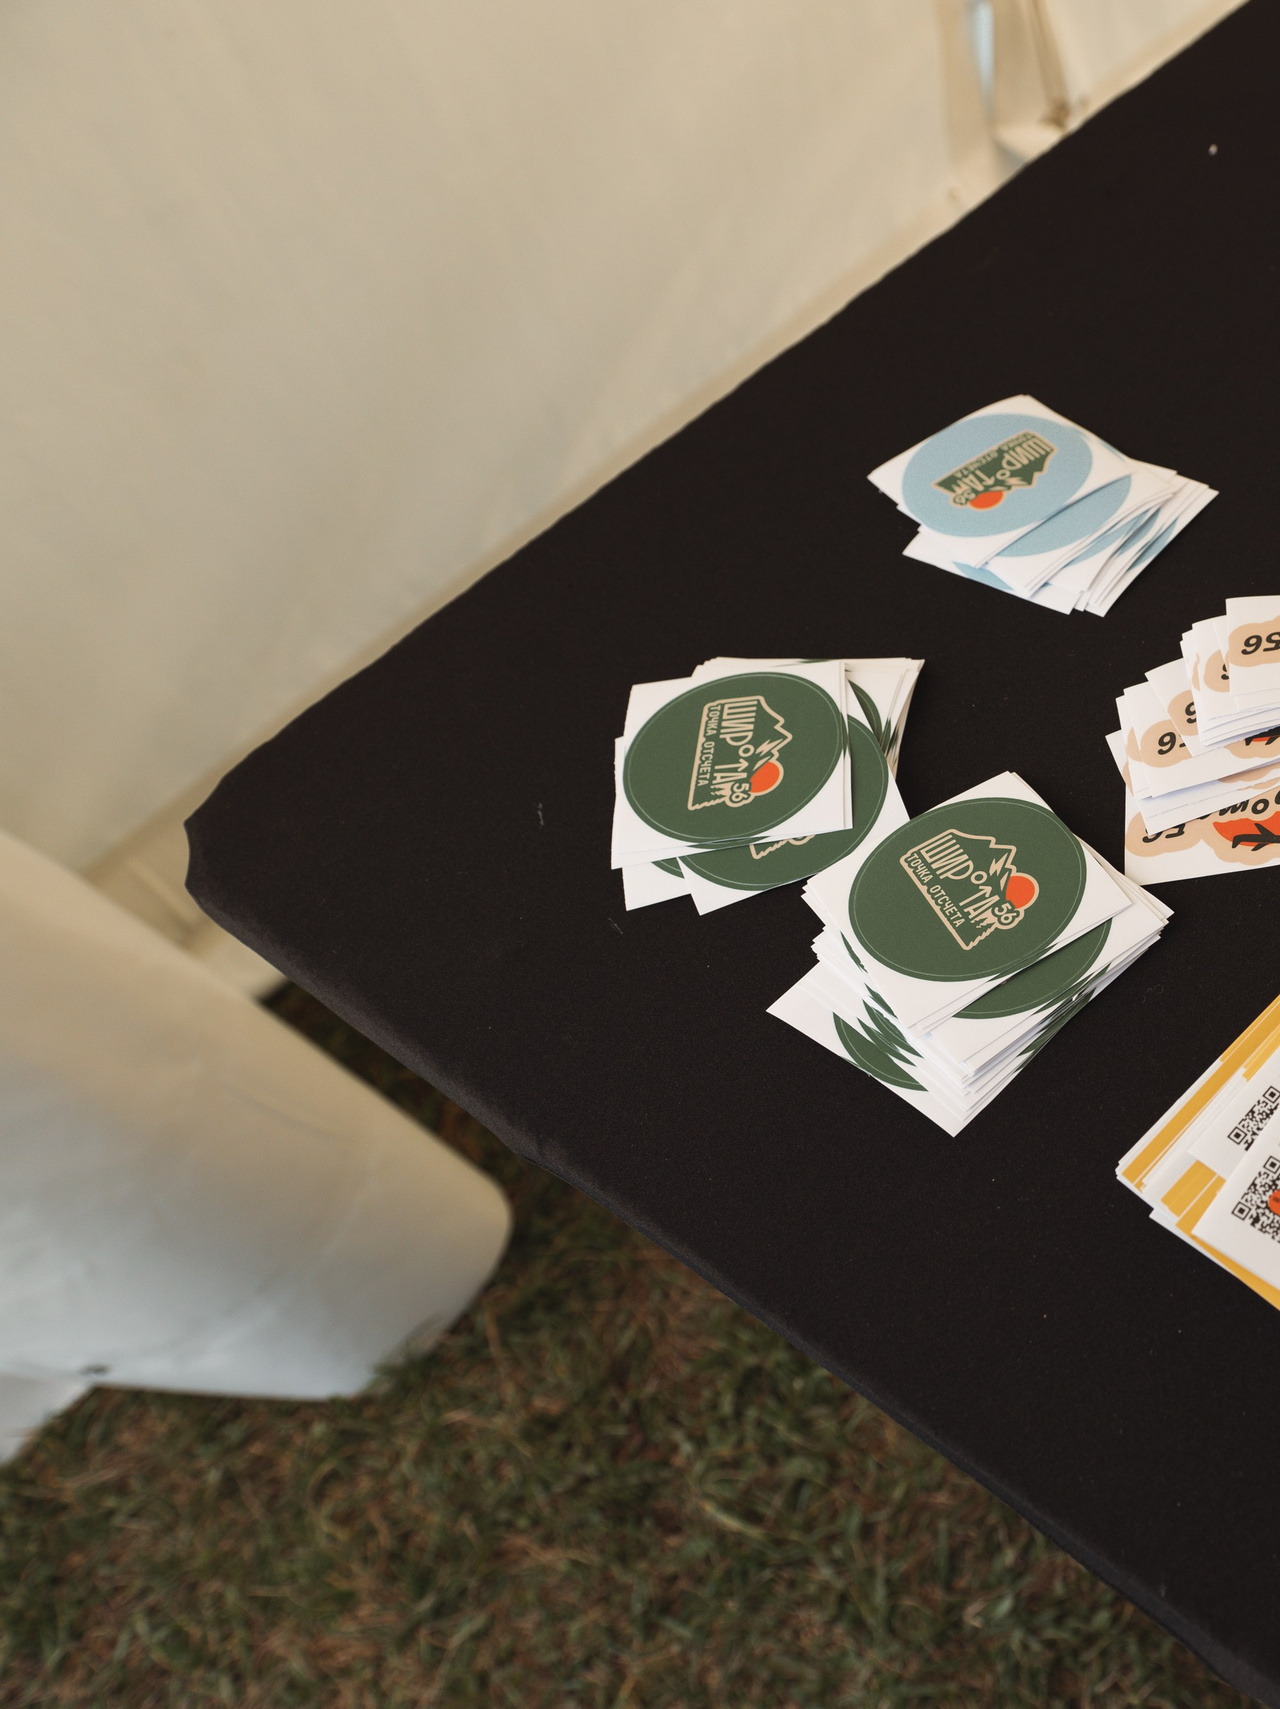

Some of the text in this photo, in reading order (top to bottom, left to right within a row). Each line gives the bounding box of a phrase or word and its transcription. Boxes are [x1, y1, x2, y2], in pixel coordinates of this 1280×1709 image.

[698, 705, 721, 786] ТОЧКА ОТСЧЕТА
[907, 853, 965, 928] ТОЧКА ОТСЧЕТА
